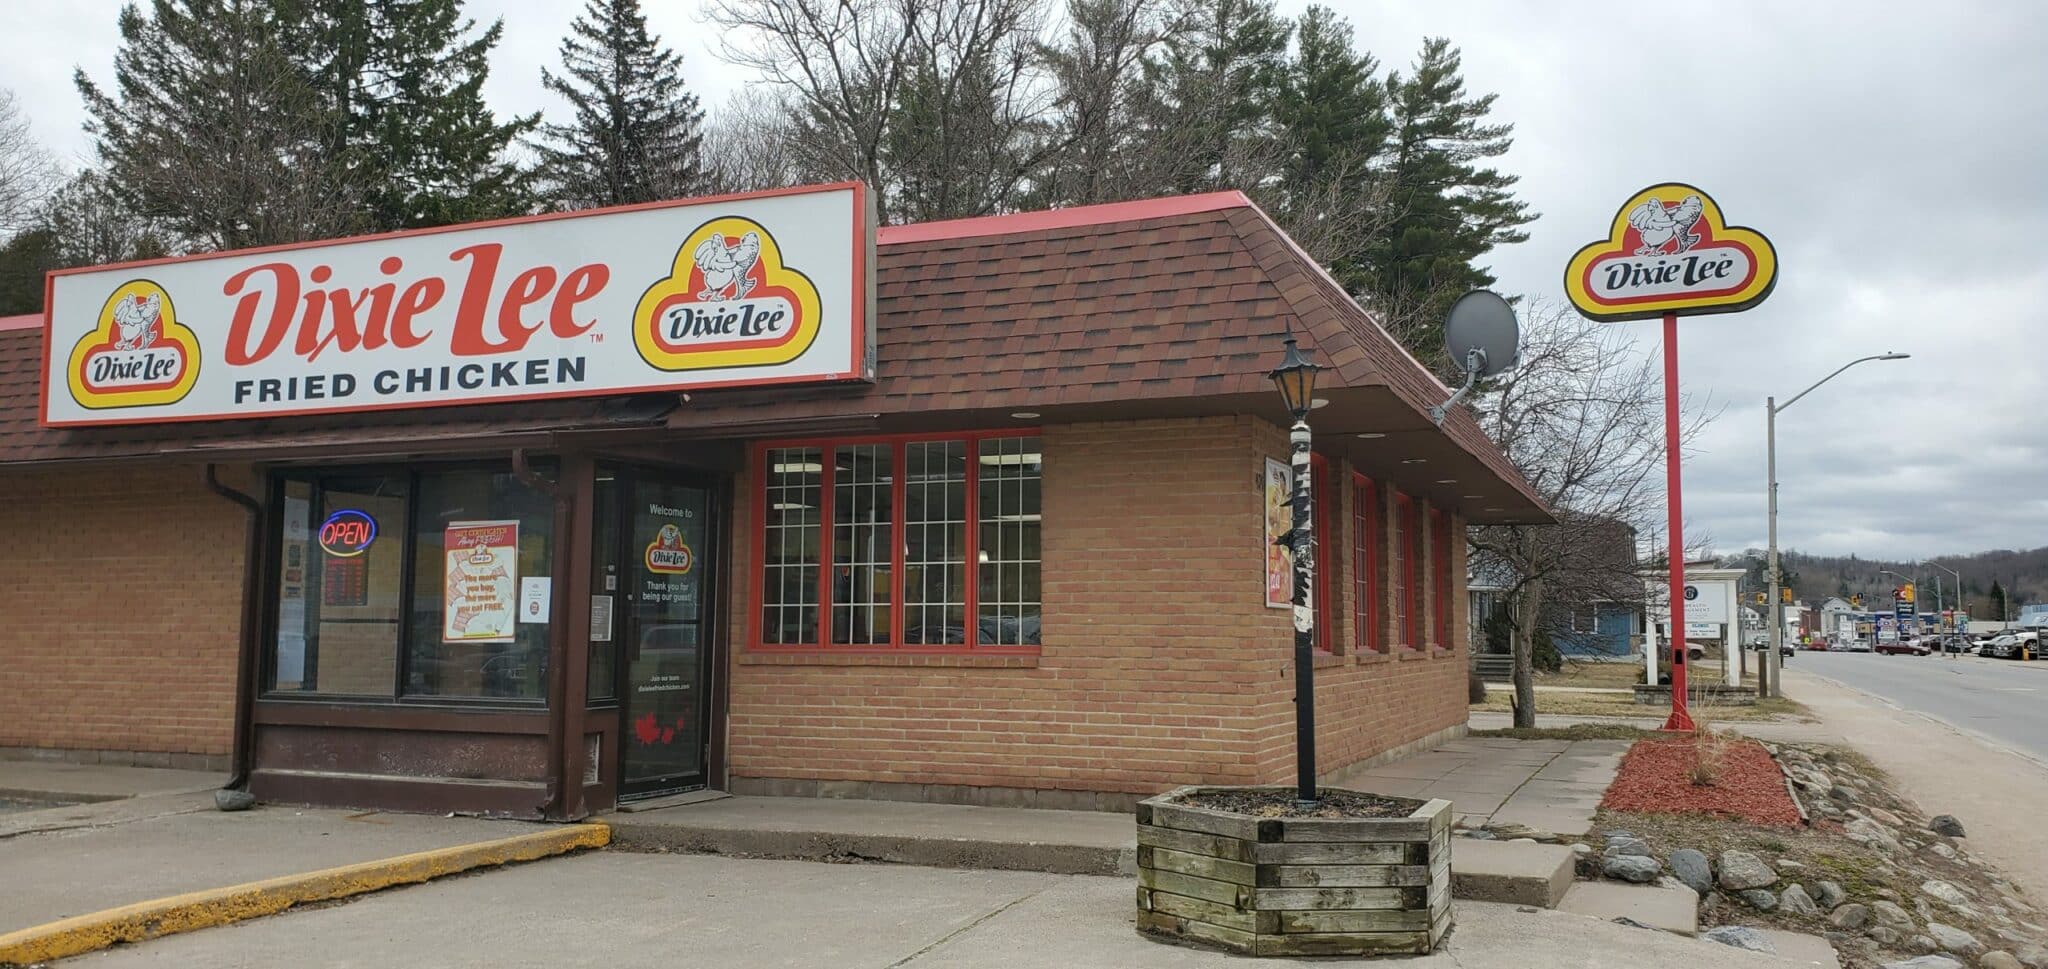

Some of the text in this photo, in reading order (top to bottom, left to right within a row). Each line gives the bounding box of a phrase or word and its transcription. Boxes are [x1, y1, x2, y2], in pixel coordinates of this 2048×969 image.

[1605, 255, 1733, 290] Dixie Lee
[223, 242, 610, 366] Dixie Lee
[669, 304, 785, 339] Dixie Lee
[590, 333, 604, 343] TM
[94, 353, 176, 382] Dixie Lee
[234, 356, 586, 405] FRIED CHICKEN
[649, 504, 693, 518] Welcome to
[322, 522, 370, 545] OPEN
[653, 551, 686, 565] Dixie Lee
[642, 592, 661, 602] being
[647, 581, 666, 590] Thank
[667, 582, 679, 592] you
